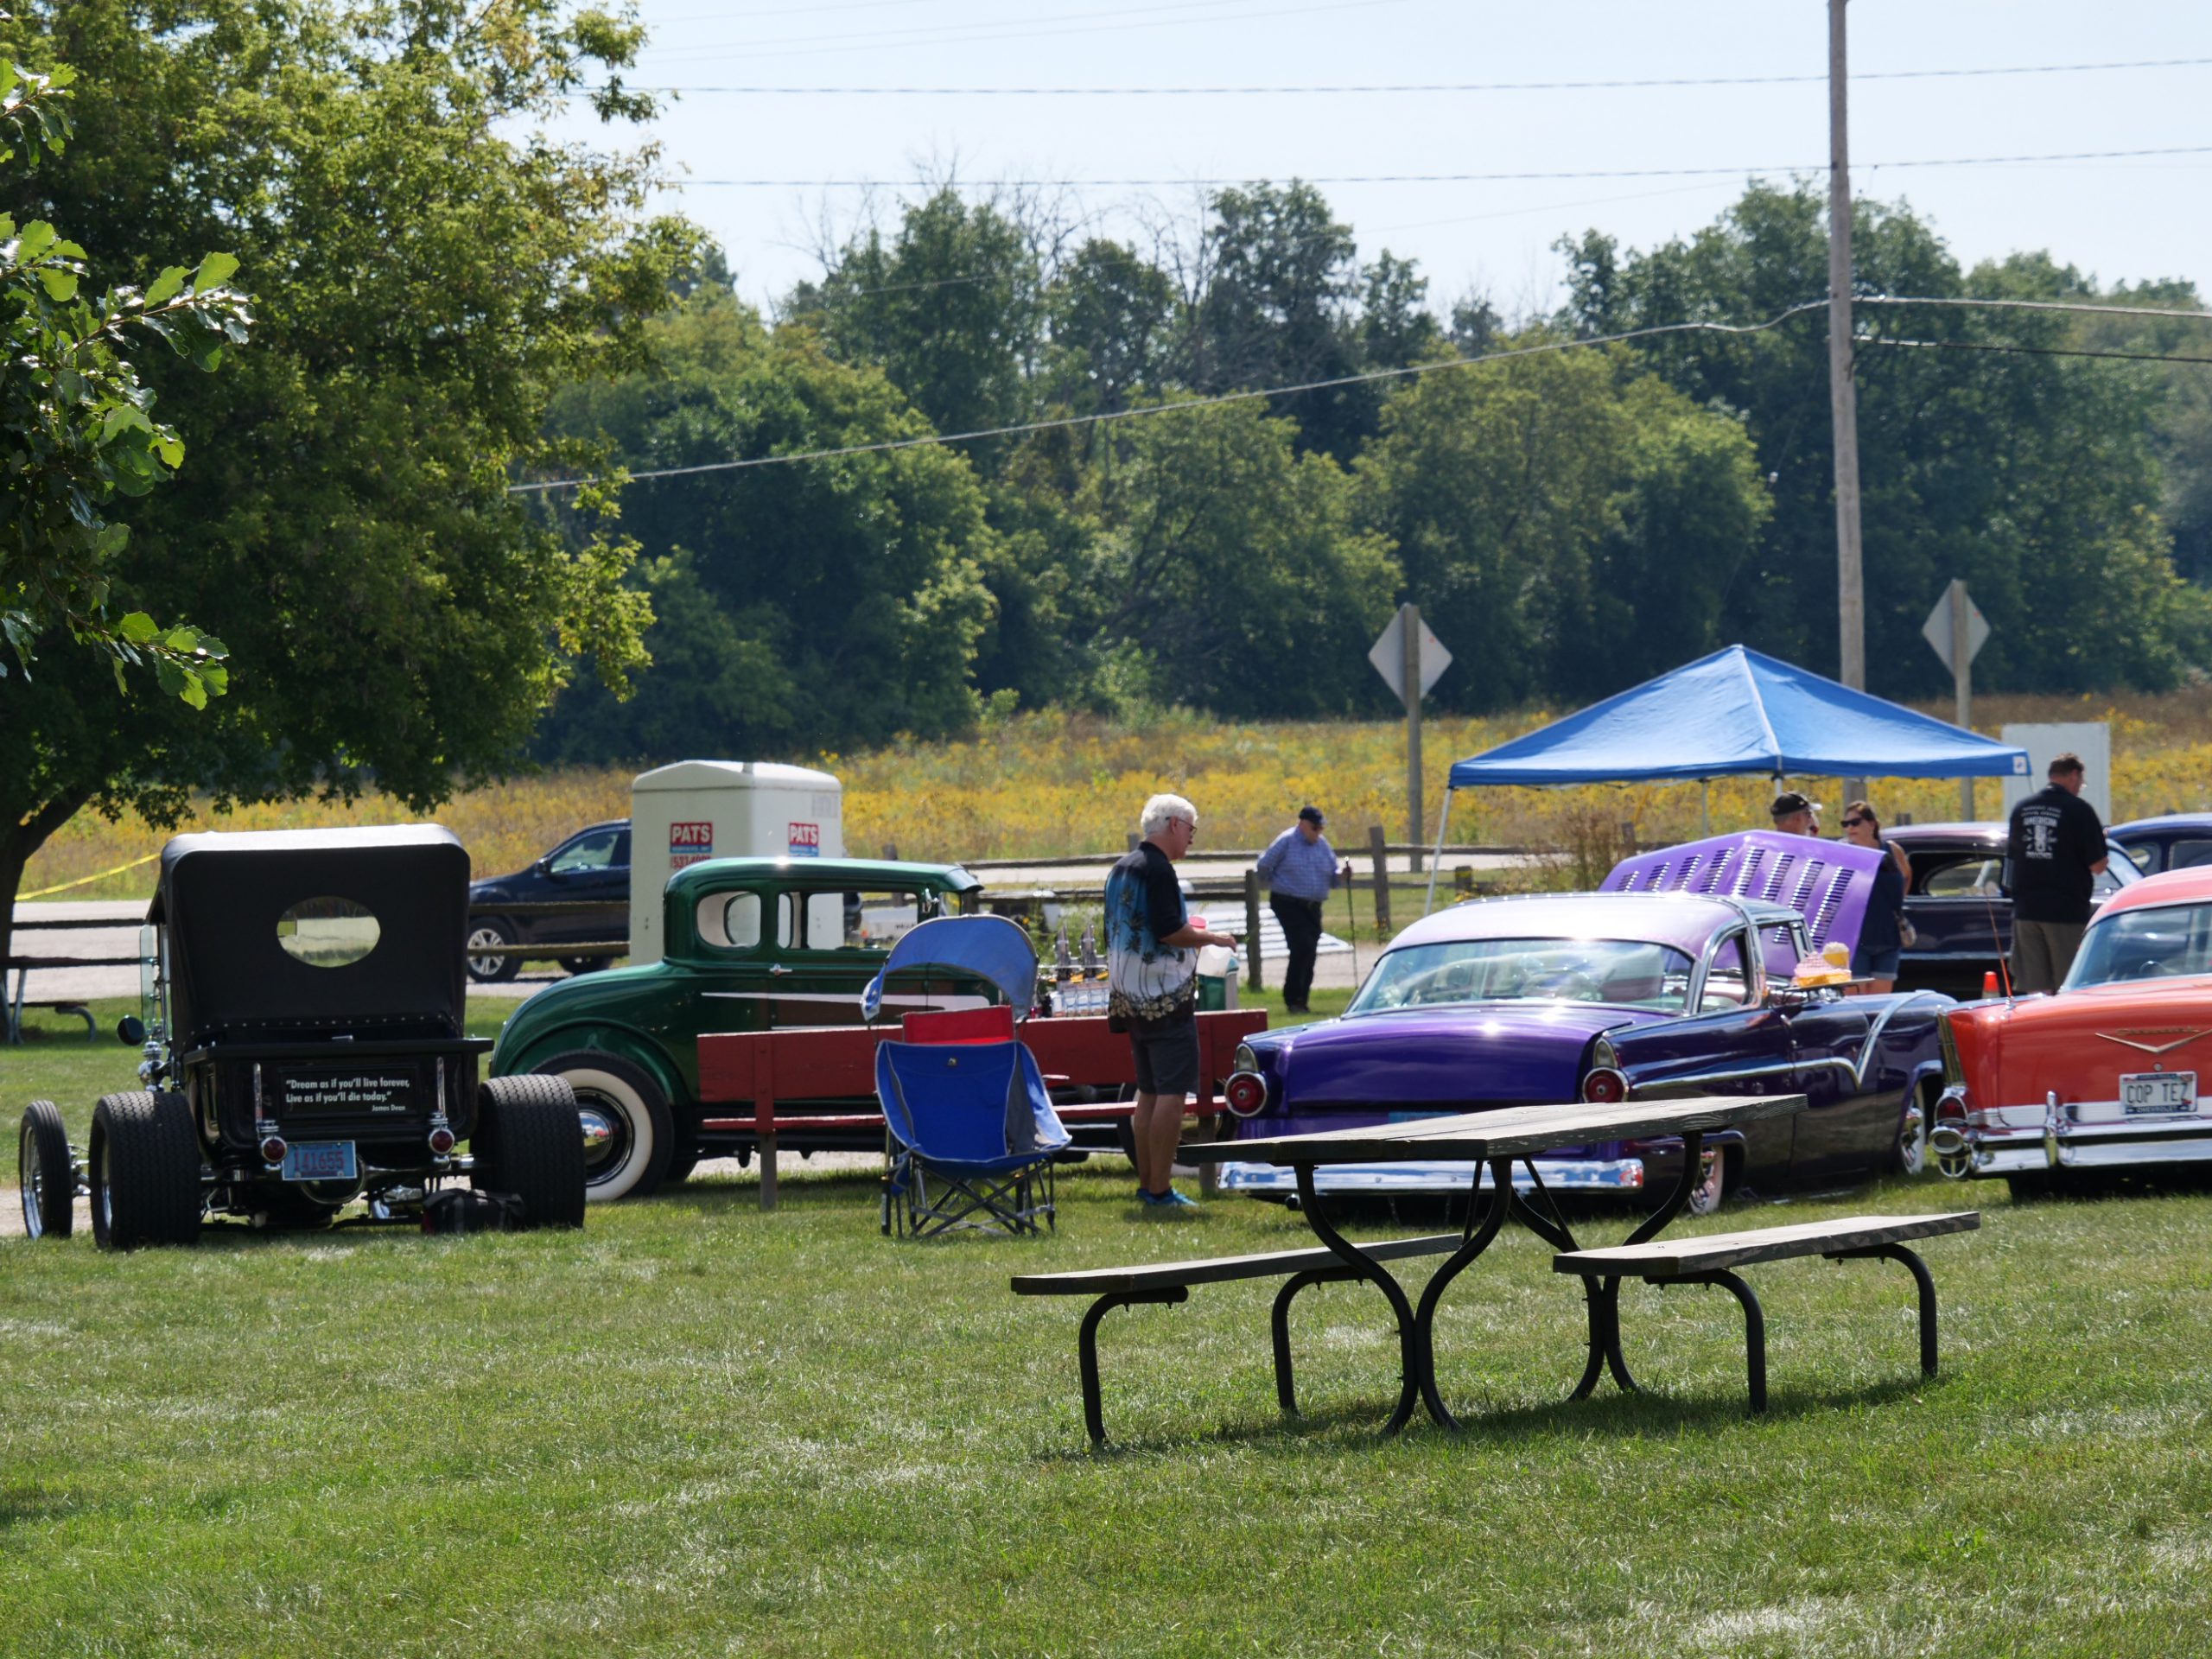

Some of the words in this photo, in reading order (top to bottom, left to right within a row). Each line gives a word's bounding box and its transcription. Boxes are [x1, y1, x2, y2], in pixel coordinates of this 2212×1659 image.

[672, 824, 710, 843] PATS
[790, 824, 818, 845] PATS
[320, 1081, 329, 1090] as
[330, 1078, 337, 1089] if
[363, 1077, 378, 1088] live
[379, 1076, 410, 1089] forever,
[286, 1093, 302, 1103] Live
[304, 1094, 314, 1103] as
[315, 1091, 322, 1103] if
[347, 1091, 361, 1102] die
[2126, 1084, 2153, 1104] COP
[2162, 1082, 2188, 1103] TEZ
